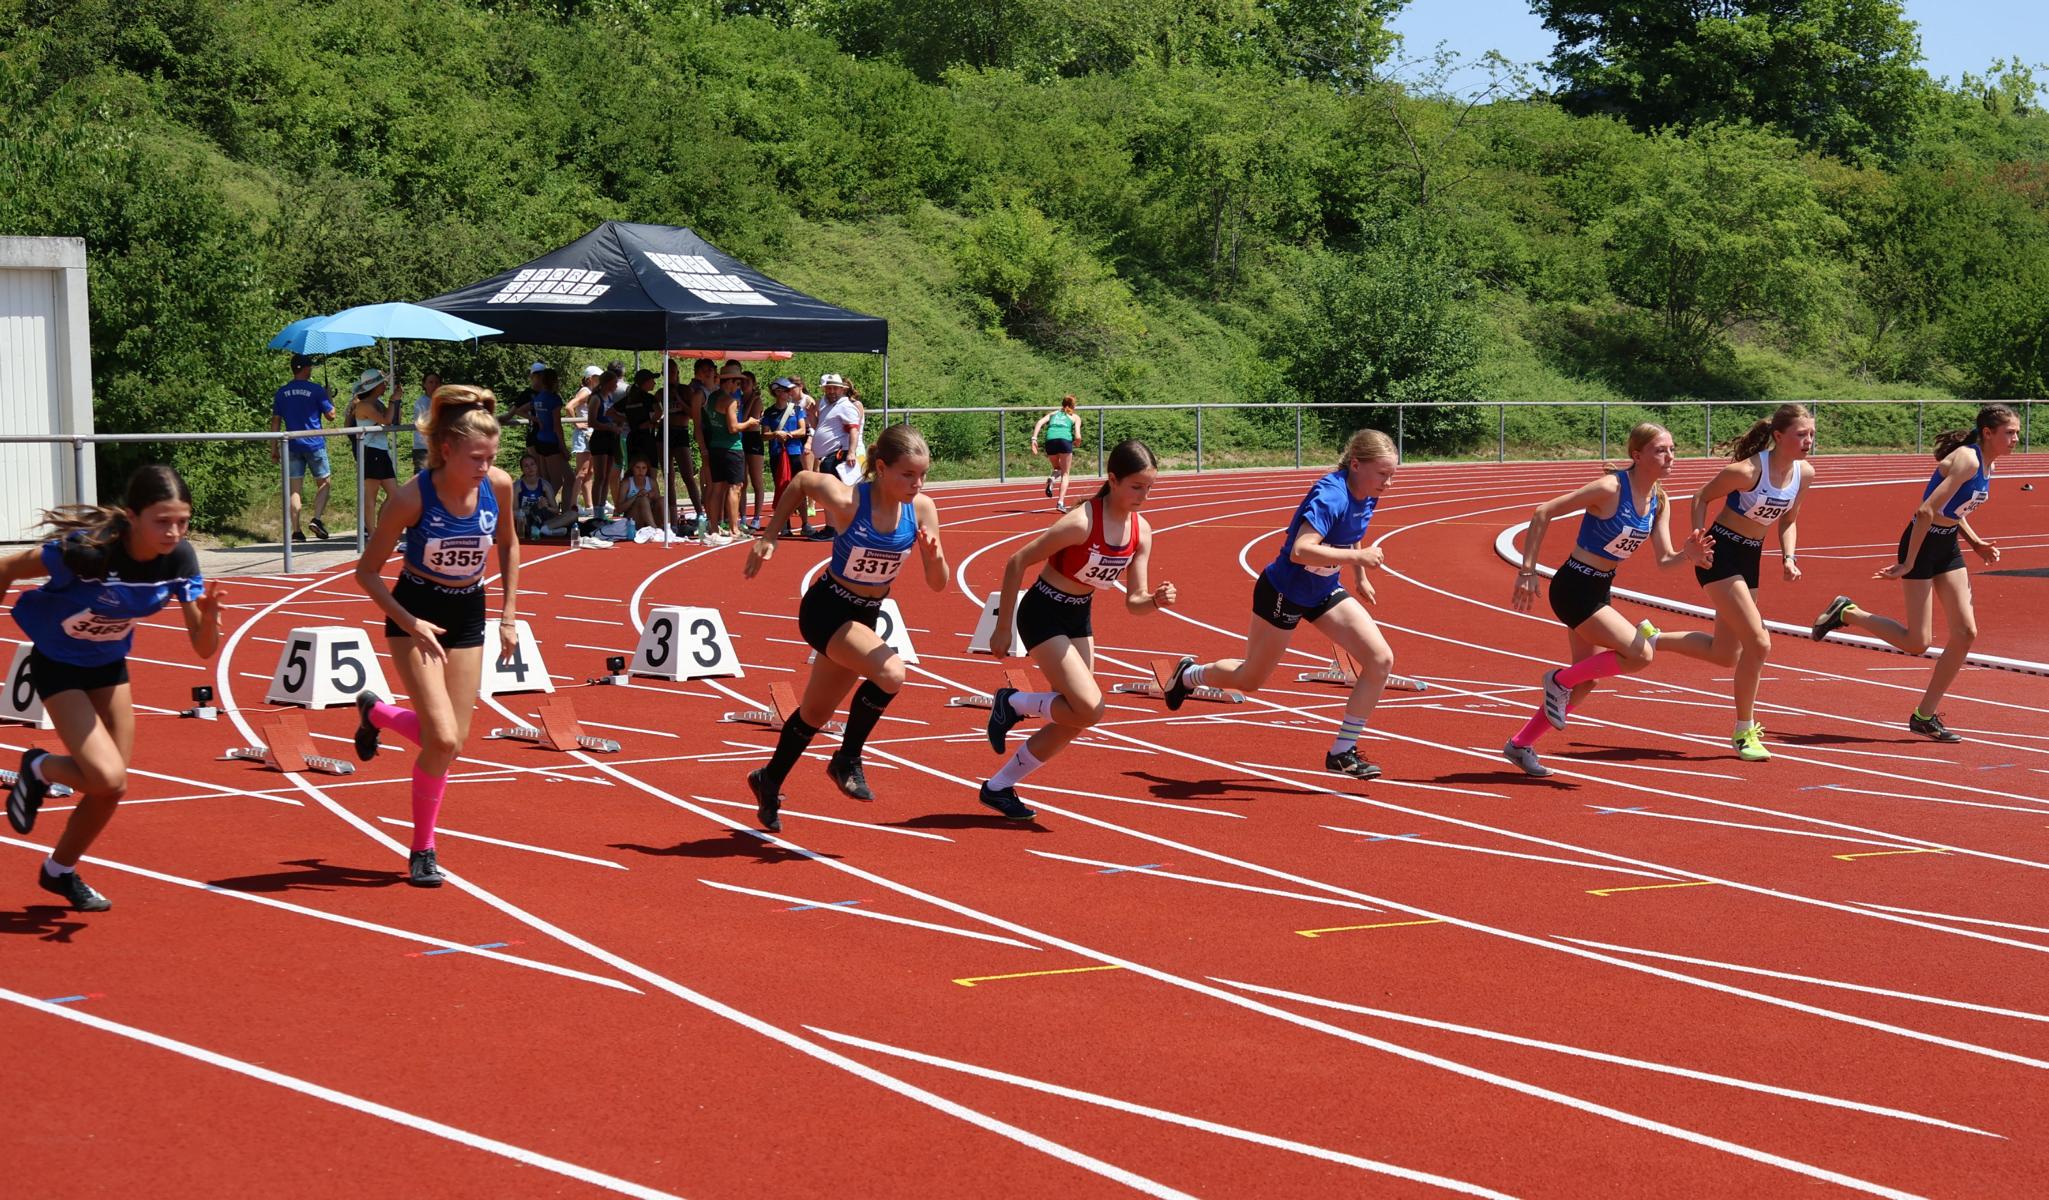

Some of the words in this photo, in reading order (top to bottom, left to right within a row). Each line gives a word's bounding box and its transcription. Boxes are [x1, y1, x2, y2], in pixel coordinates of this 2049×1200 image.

[518, 269, 602, 281] SPORT
[430, 550, 485, 567] 3355
[830, 583, 866, 605] NIKE
[1035, 580, 1066, 602] NIKE
[1064, 596, 1090, 605] PRO
[283, 640, 312, 693] 5
[495, 634, 528, 682] 4
[646, 618, 672, 667] 3
[690, 619, 722, 667] 3
[13, 655, 35, 712] 6
[330, 641, 366, 694] 5
